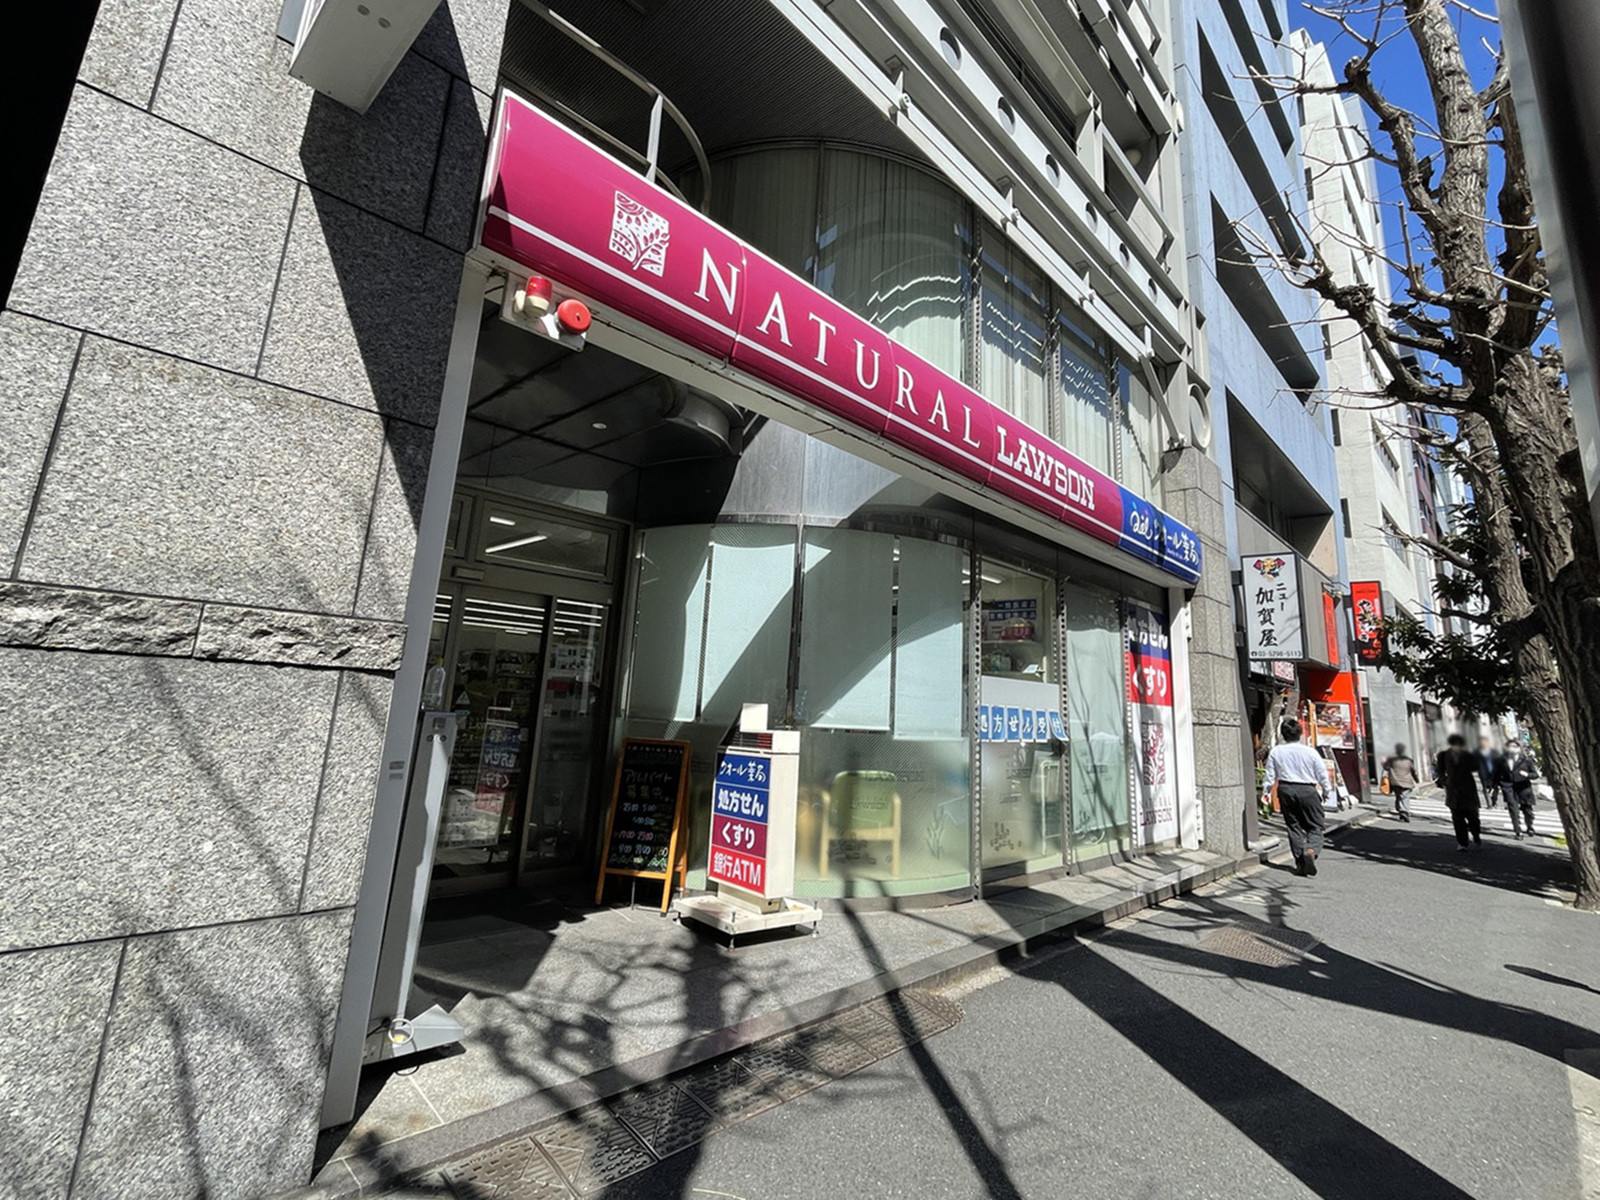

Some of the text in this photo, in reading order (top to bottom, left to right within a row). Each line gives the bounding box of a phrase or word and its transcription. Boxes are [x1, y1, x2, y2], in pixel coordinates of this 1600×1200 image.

[694, 247, 1095, 510] NATURAL LAWSON
[1276, 582, 1287, 611] ニュー
[1255, 587, 1278, 647] 加賀屋
[1133, 665, 1167, 697] くすり
[720, 761, 766, 782] クオール薬局
[718, 788, 764, 817] 処方せん
[721, 821, 755, 849] くすり
[713, 851, 761, 887] 銀行ATM
